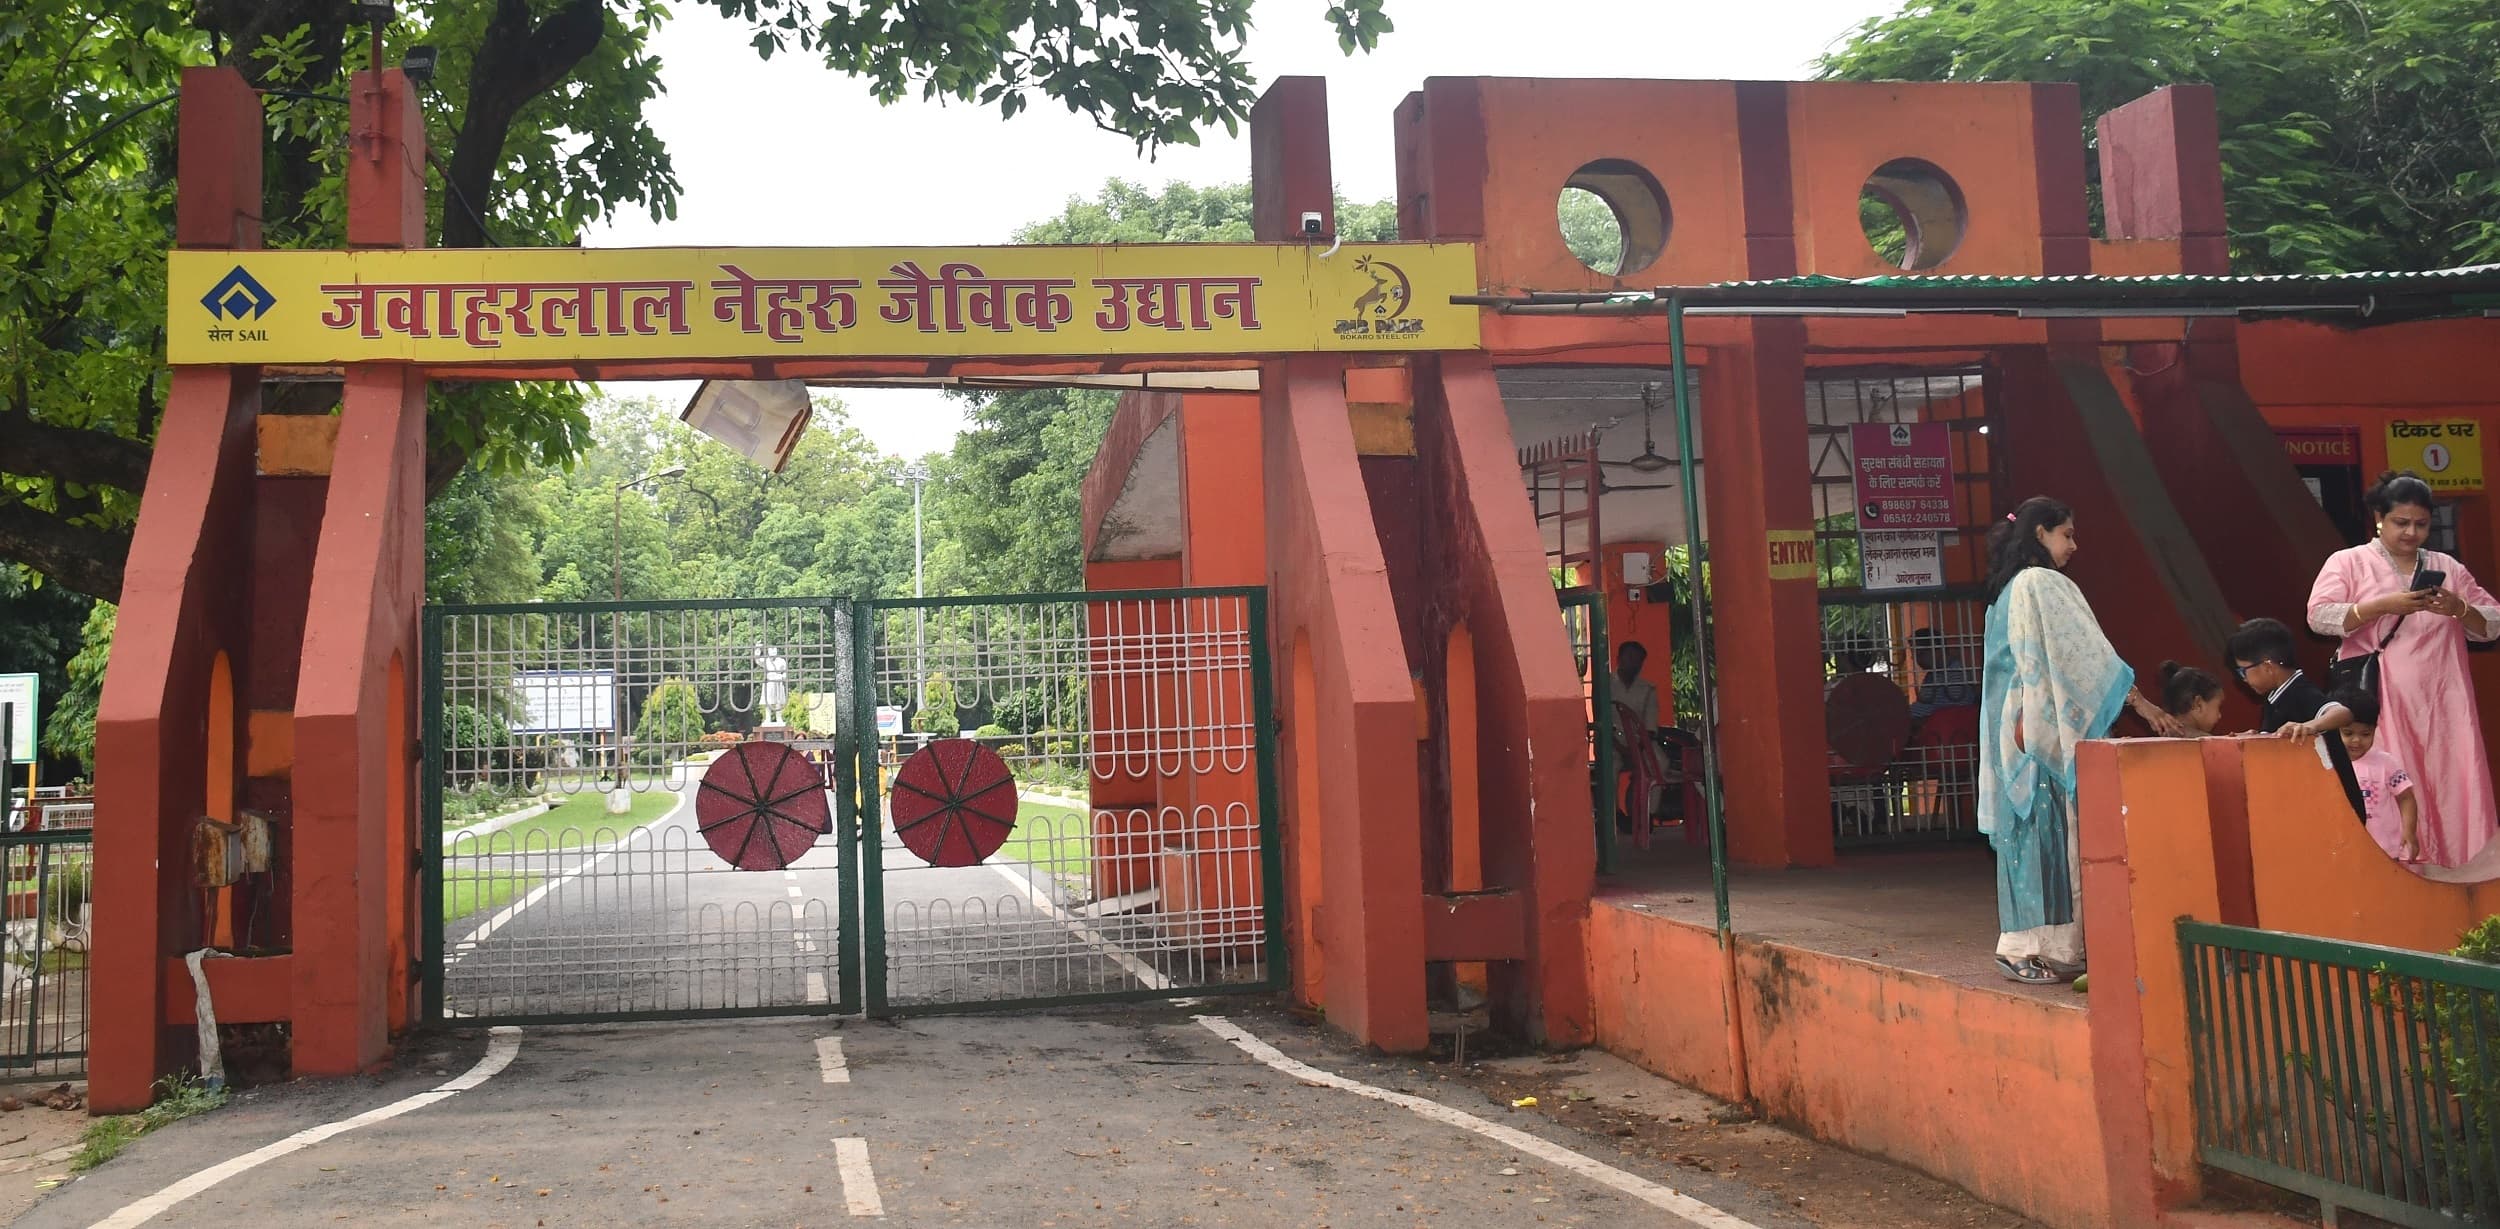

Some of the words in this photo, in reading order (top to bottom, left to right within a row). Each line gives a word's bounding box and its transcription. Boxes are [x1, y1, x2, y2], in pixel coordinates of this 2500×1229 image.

[320, 281, 695, 348] जवाहरलाल
[878, 262, 1076, 333] जैविक
[1092, 276, 1263, 332] उद्यान
[207, 325, 234, 342] सेल
[239, 330, 269, 342] SAIL
[1375, 319, 1425, 334] PARK
[2390, 420, 2442, 438] टिकट
[2447, 422, 2475, 438] घर
[1860, 457, 1886, 473] सुरक्षा
[1912, 457, 1945, 469] सहायता
[2430, 449, 2439, 466] 1
[1868, 475, 1877, 489] के
[1879, 474, 1896, 489] लिए
[1768, 540, 1814, 566] ENTRY
